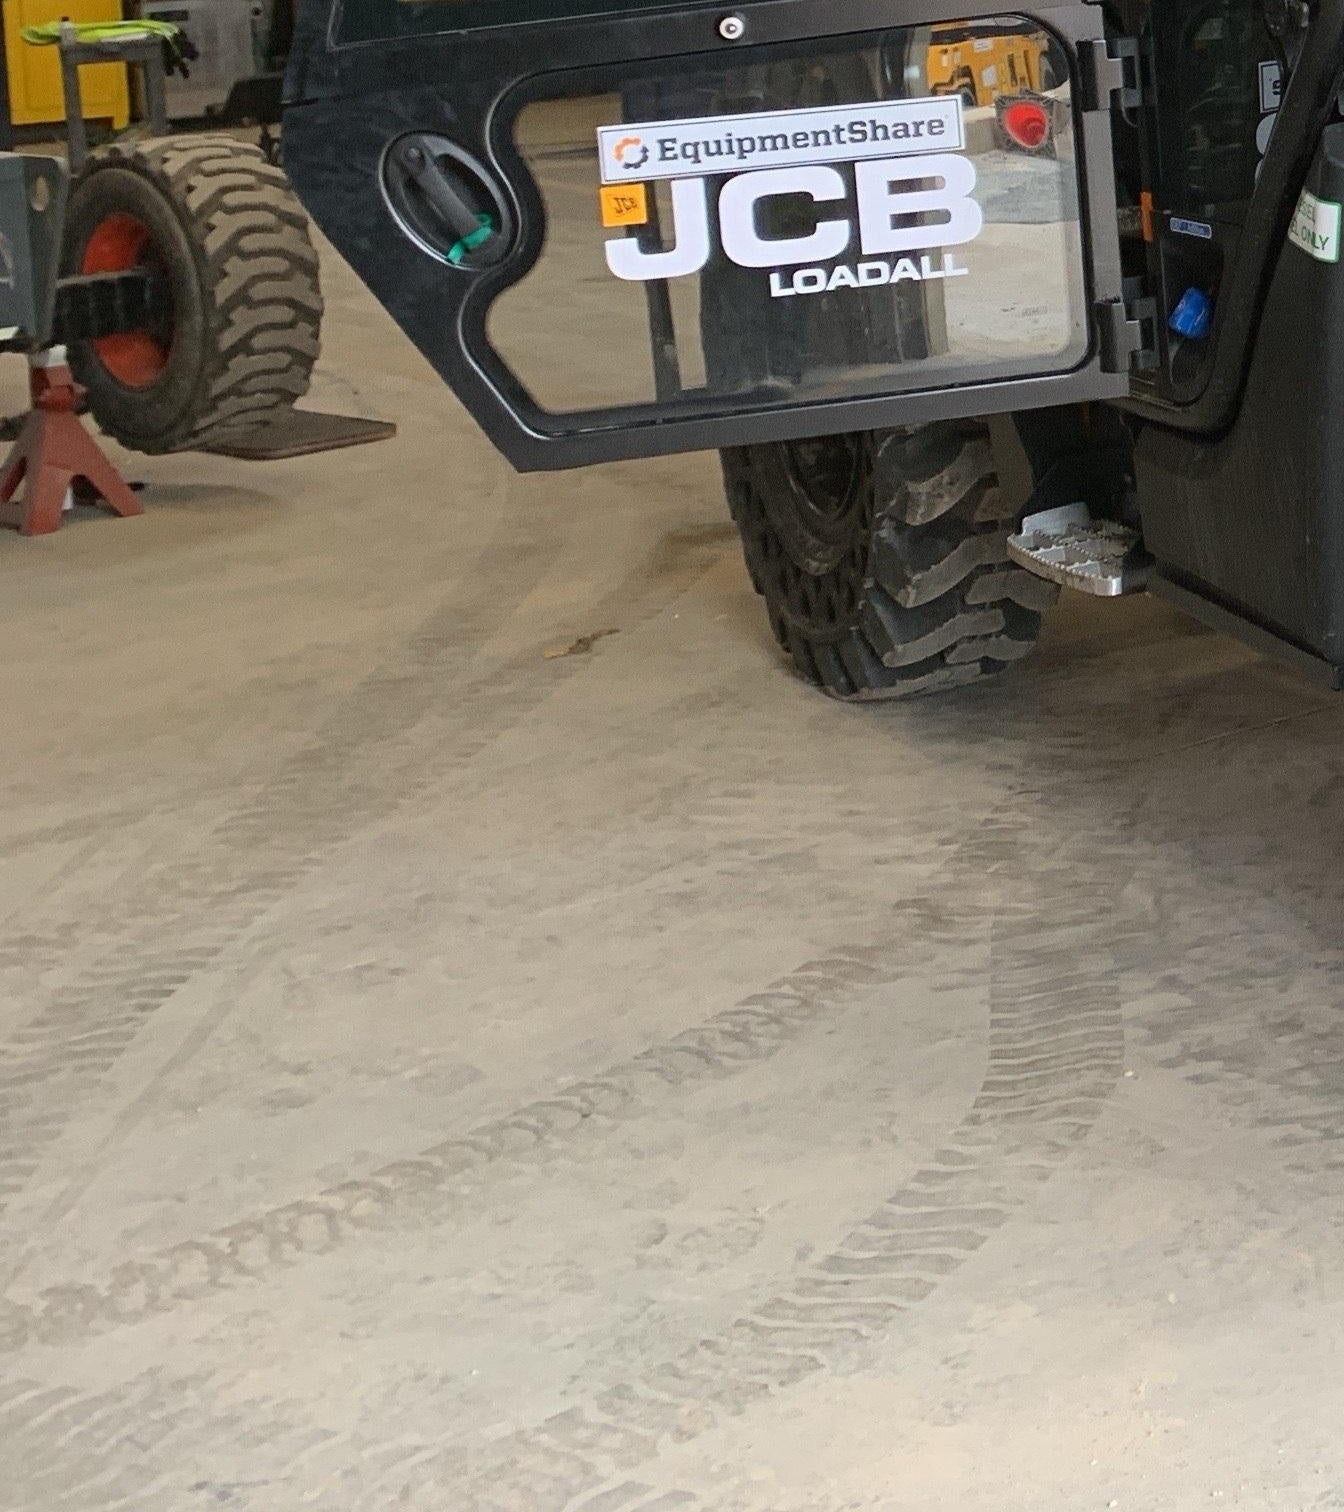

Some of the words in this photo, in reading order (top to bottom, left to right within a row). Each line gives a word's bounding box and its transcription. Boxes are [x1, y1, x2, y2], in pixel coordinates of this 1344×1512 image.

[657, 118, 946, 165] EquipmentShare
[605, 152, 983, 281] JCB
[1301, 226, 1330, 250] ONLY
[769, 253, 970, 298] LOADALL
